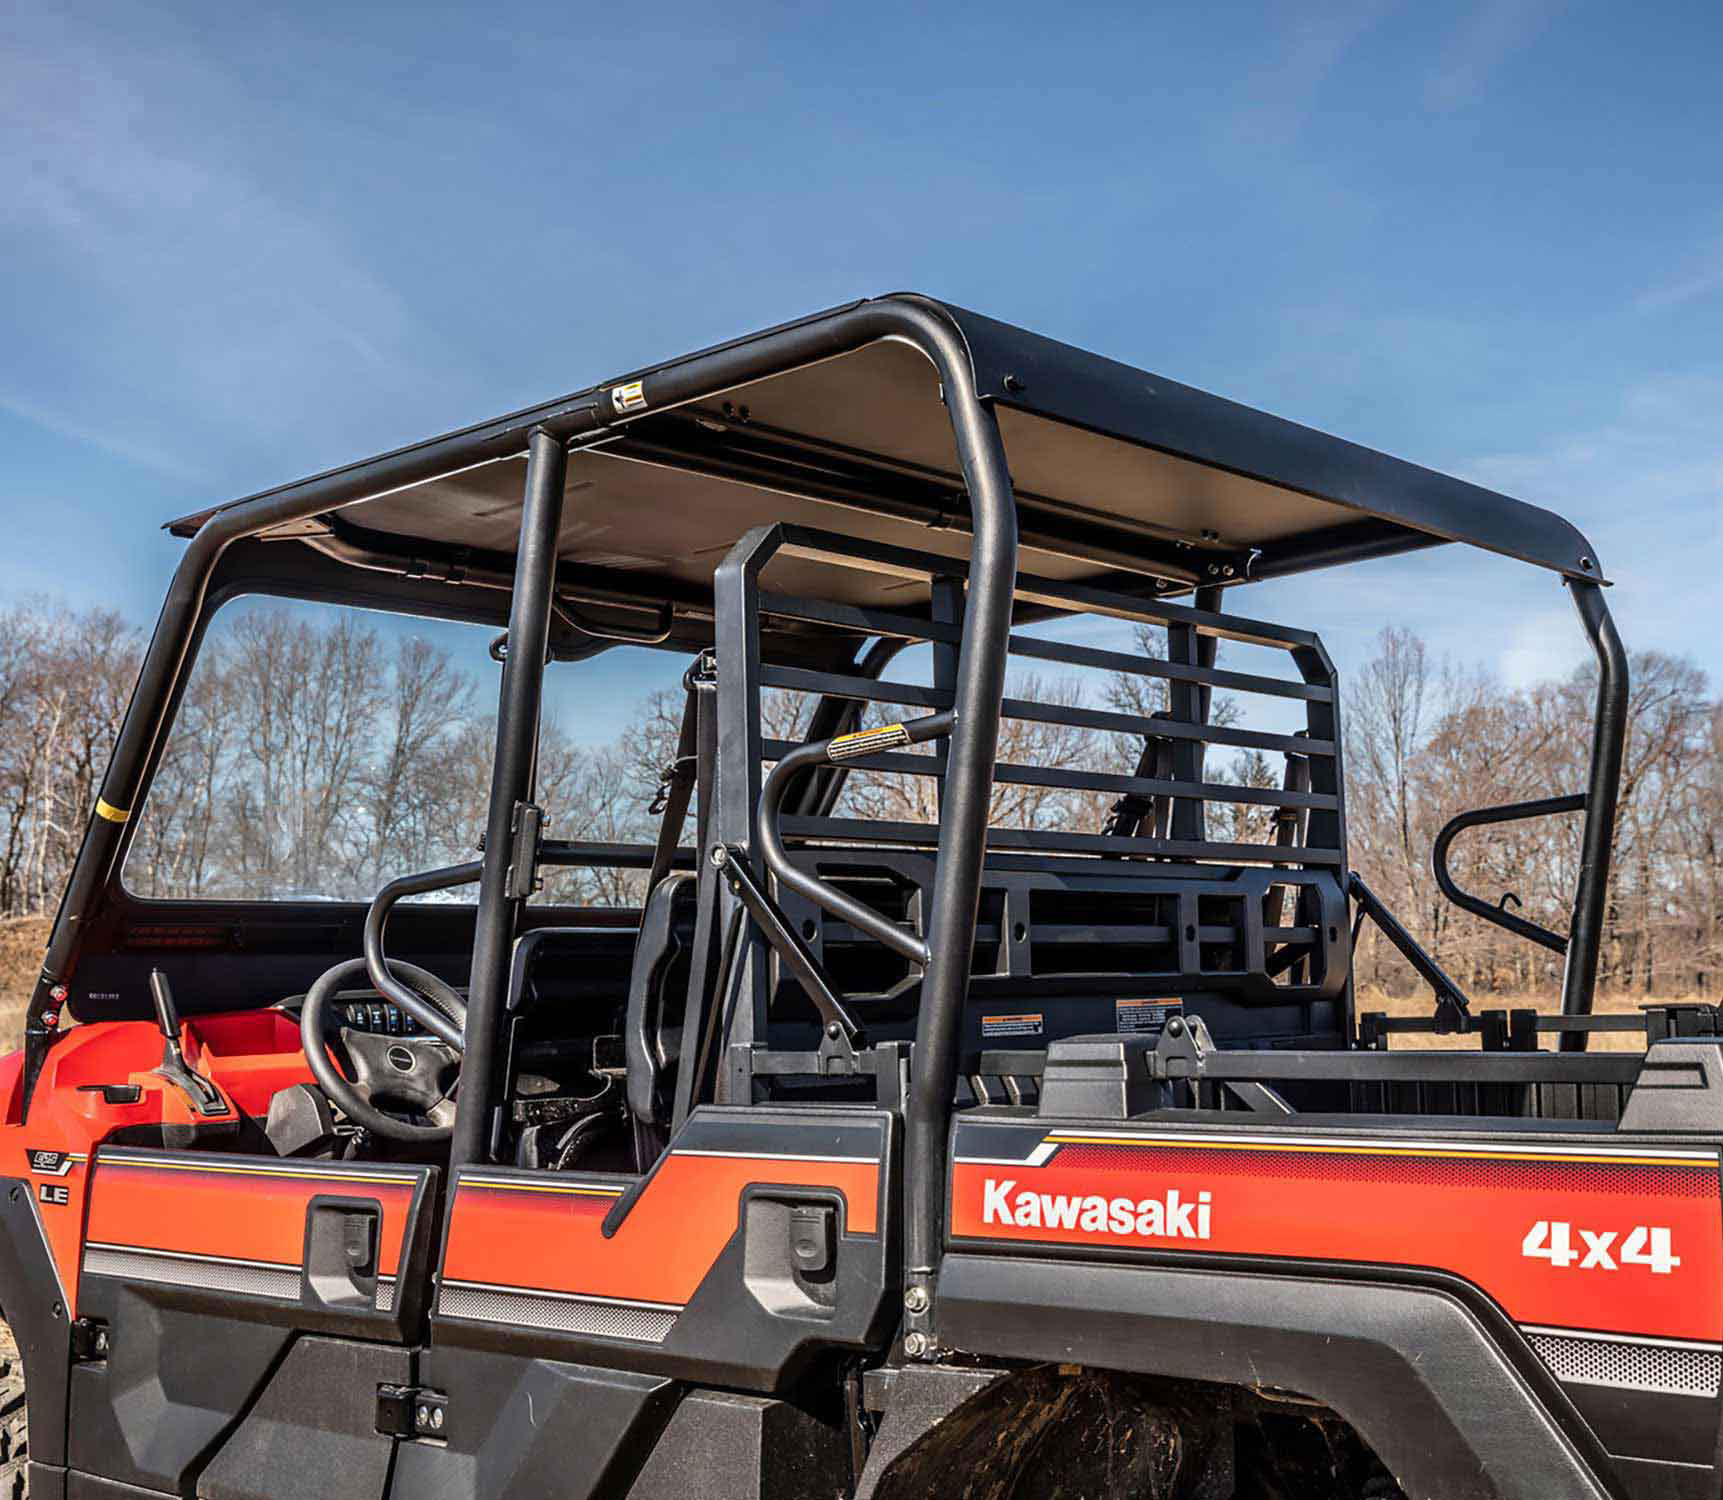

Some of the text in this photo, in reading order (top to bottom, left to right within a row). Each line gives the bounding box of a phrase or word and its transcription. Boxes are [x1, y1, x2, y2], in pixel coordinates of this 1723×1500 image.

[40, 1185, 68, 1203] LE
[983, 1178, 1212, 1240] Kawasaki
[1522, 1220, 1681, 1274] 4x4
